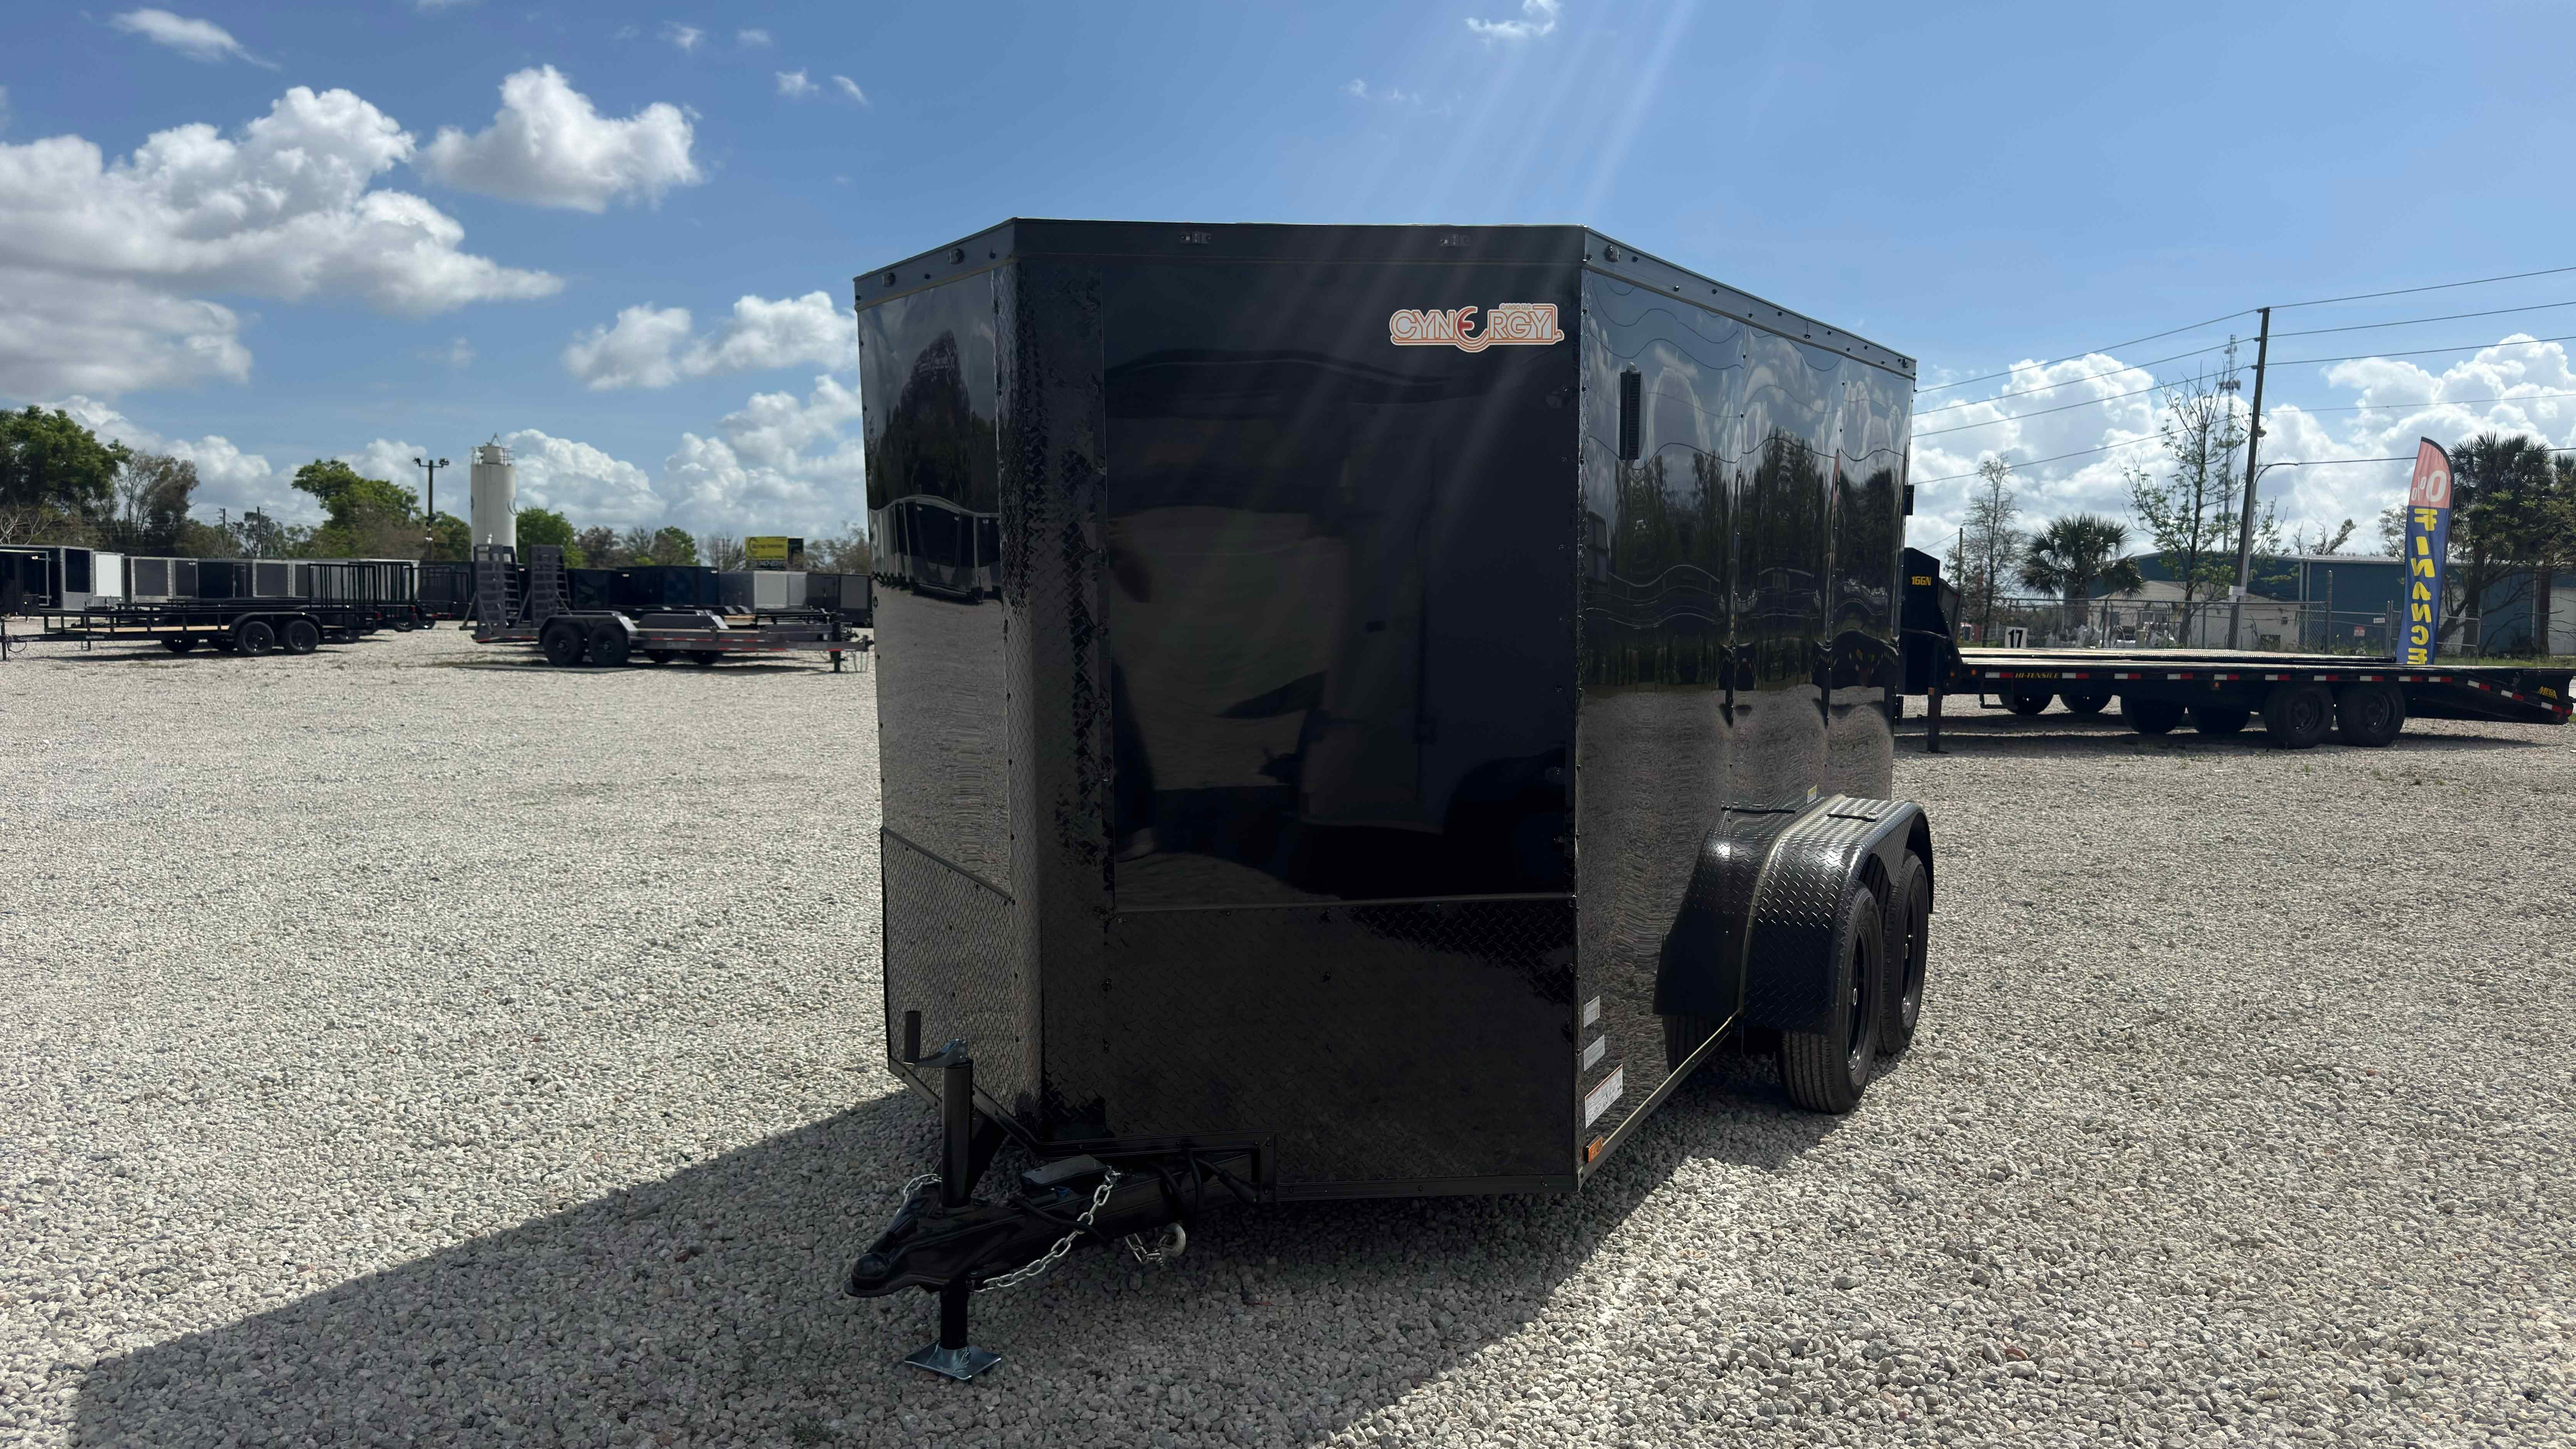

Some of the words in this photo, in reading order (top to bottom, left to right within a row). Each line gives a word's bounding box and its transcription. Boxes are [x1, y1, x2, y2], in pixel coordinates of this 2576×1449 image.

[1390, 307, 1553, 342] CYNERGY
[2008, 629, 2023, 648] 17
[2539, 686, 2558, 699] MEGA
